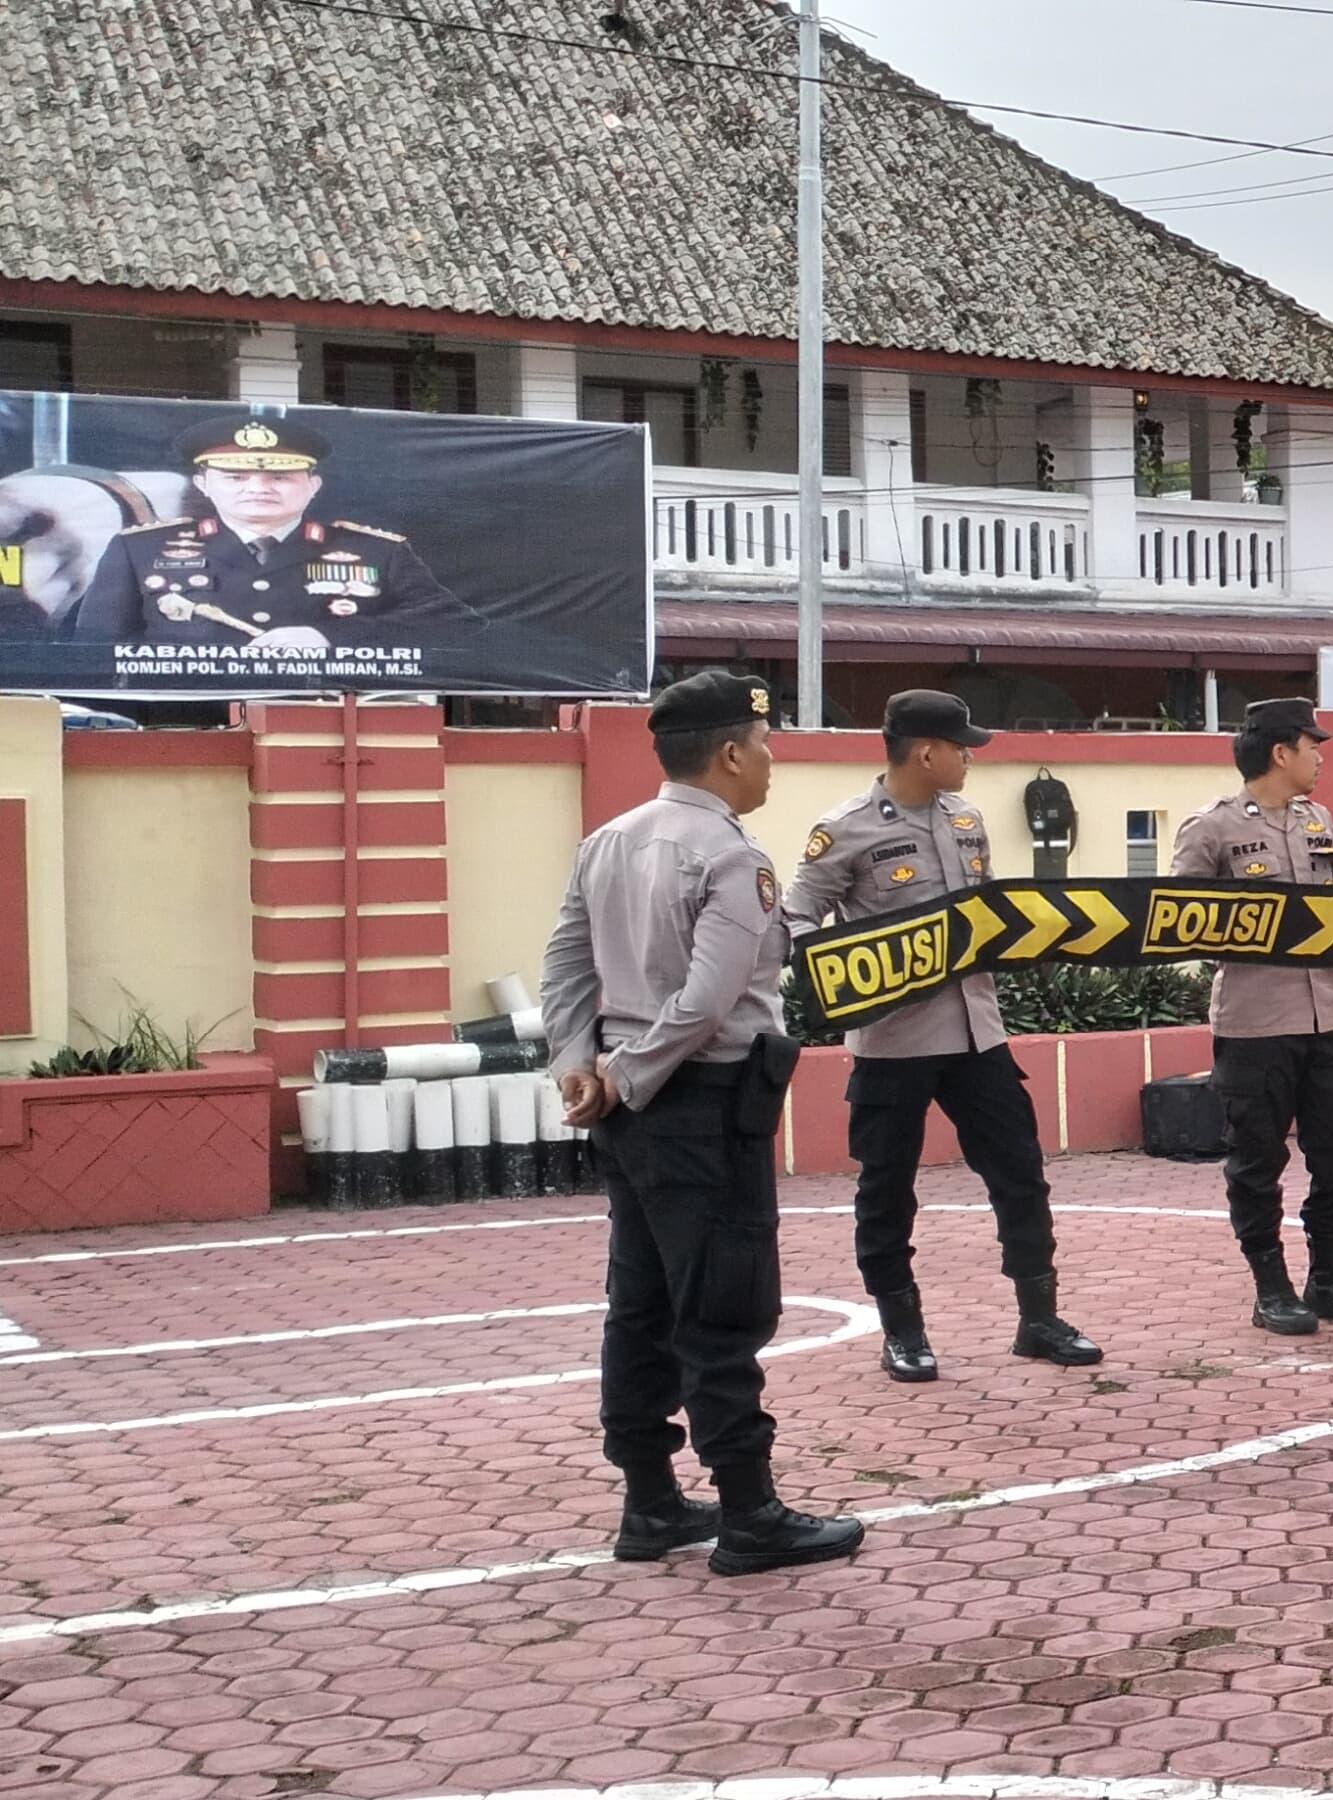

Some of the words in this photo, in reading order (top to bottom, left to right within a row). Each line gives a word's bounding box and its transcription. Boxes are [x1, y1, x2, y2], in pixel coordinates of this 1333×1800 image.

[115, 645, 326, 660] KABAHARKAM
[335, 646, 422, 661] POLRI
[116, 661, 183, 675] KOMJEN
[228, 662, 250, 675] Dr.
[254, 662, 273, 675] M.
[277, 662, 322, 675] FADIL
[326, 662, 383, 678] IMRAN,
[1232, 841, 1268, 857] REZA
[1148, 899, 1275, 944] POLISI
[815, 924, 942, 1004] POLISI
